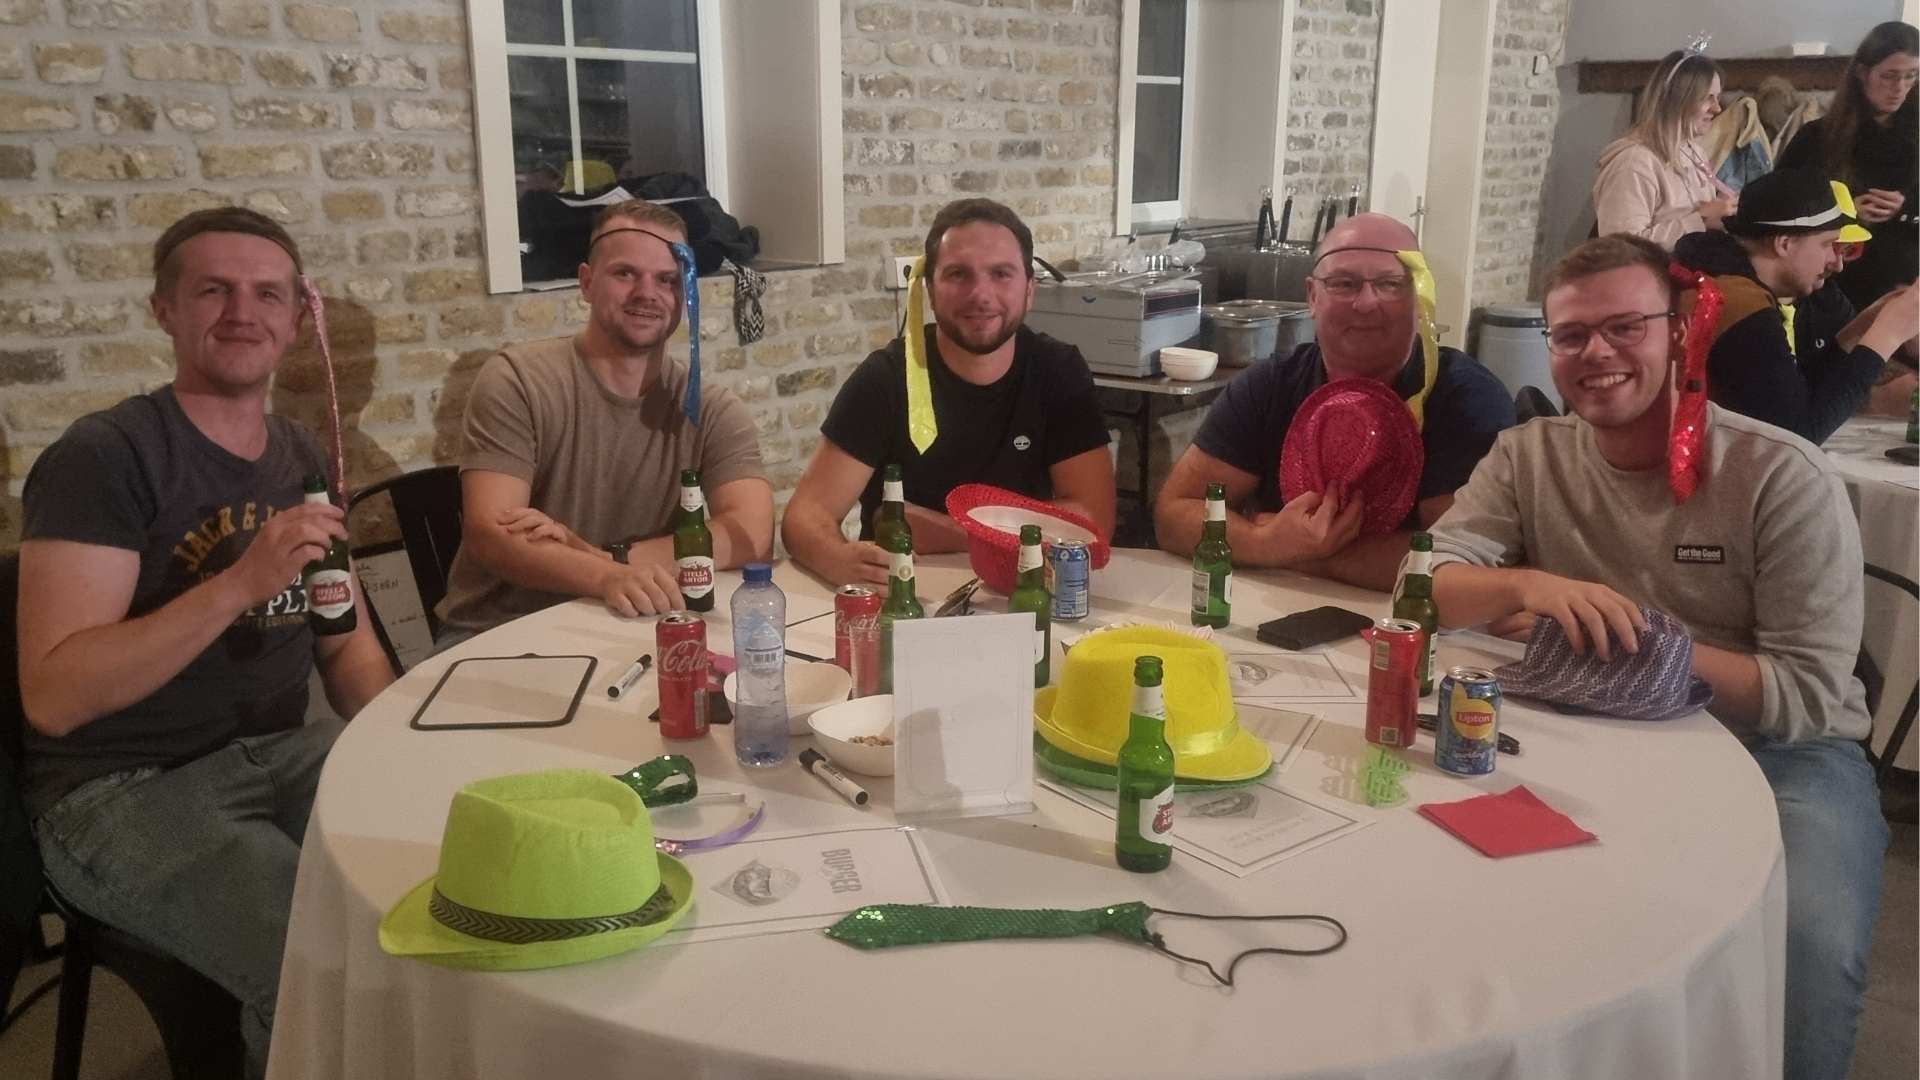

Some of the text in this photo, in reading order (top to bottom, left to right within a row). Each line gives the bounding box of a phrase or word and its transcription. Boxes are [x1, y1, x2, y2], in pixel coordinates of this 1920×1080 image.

[174, 506, 236, 572] JACK
[243, 502, 257, 530] &
[1458, 712, 1491, 724] Lipton
[820, 848, 863, 894] BURGER
